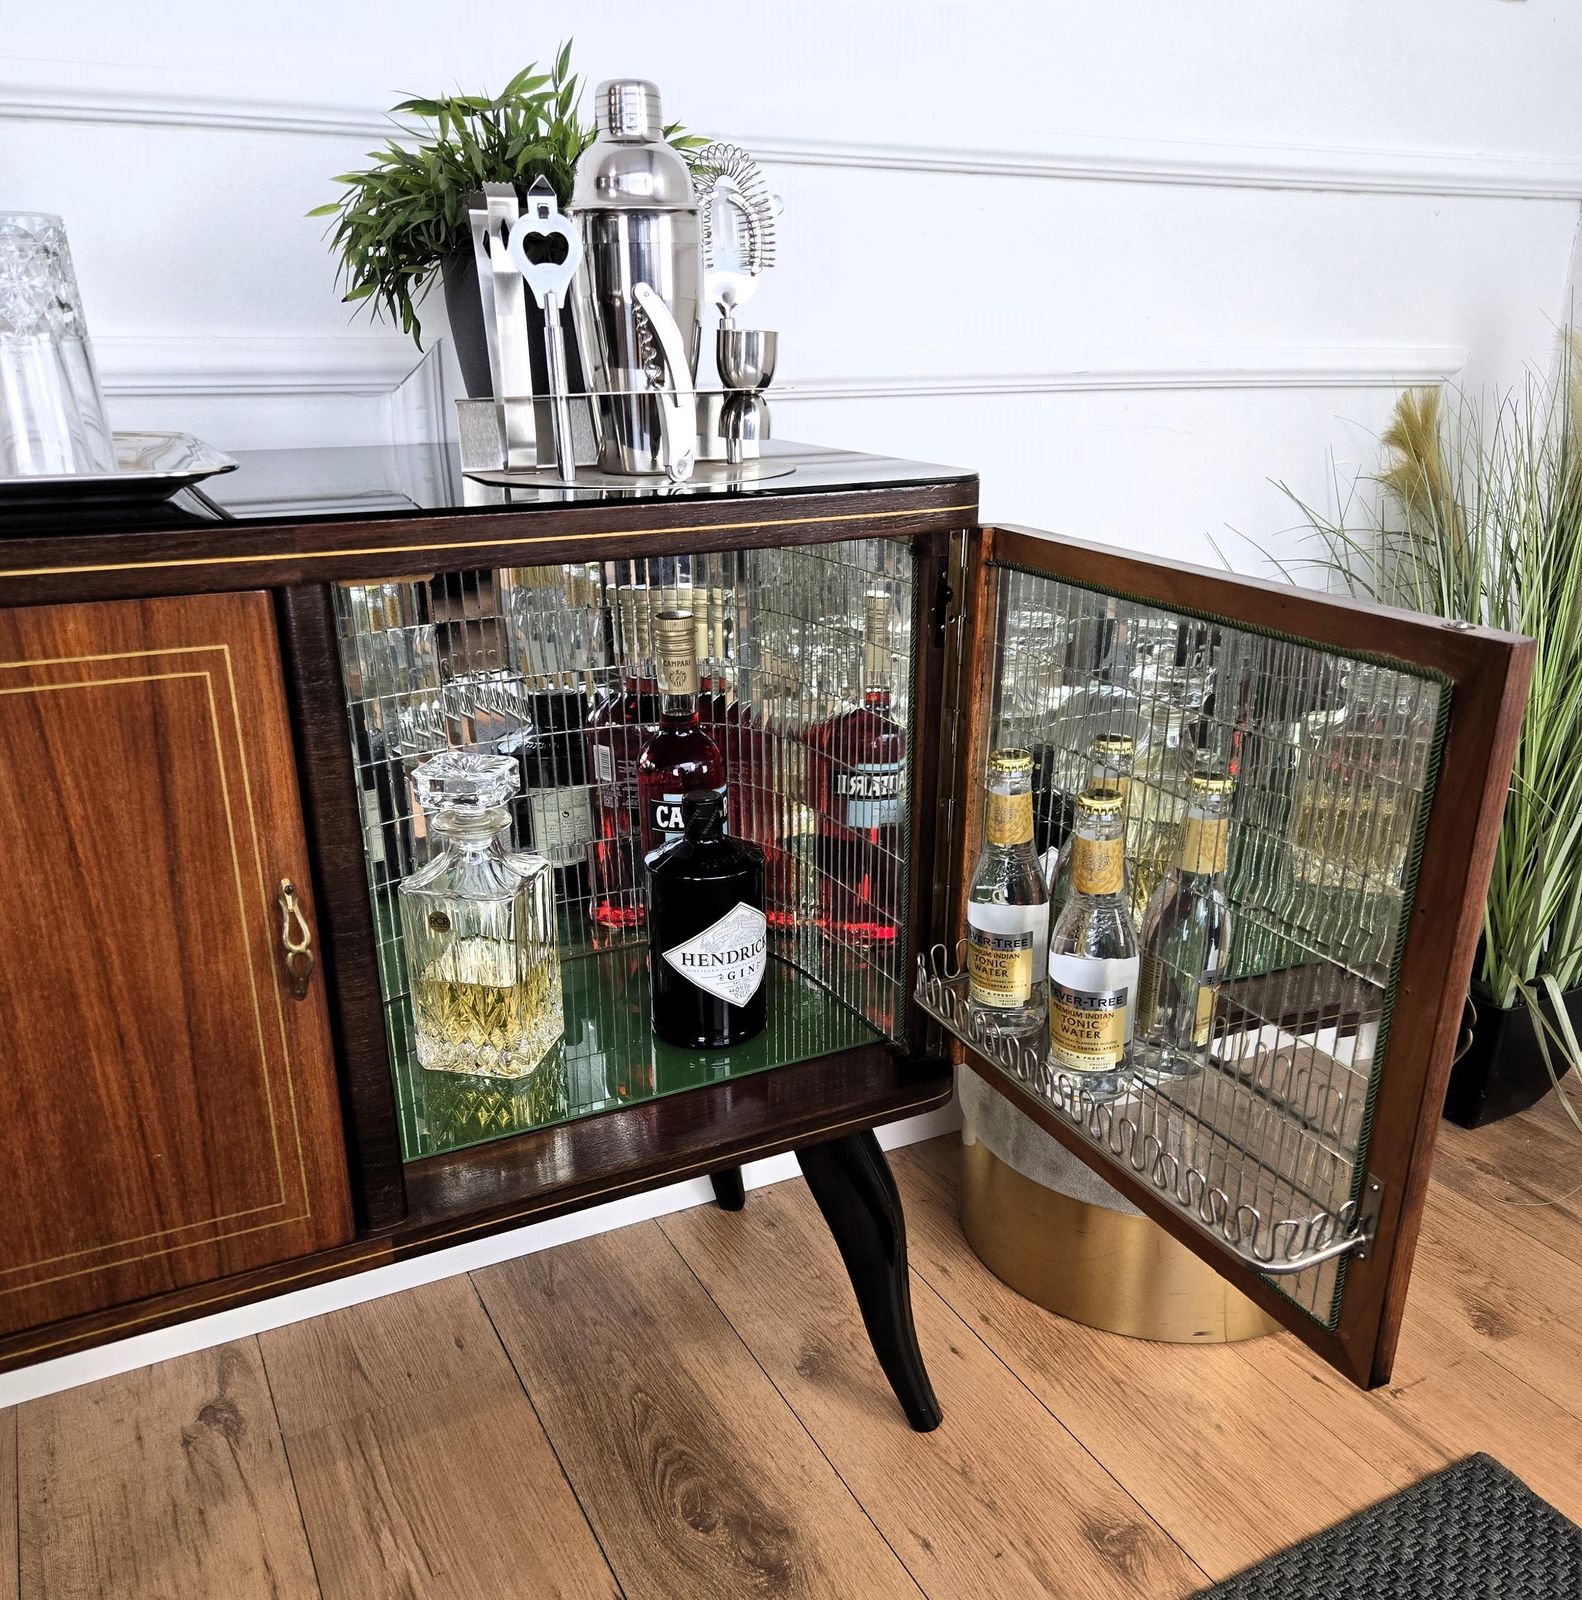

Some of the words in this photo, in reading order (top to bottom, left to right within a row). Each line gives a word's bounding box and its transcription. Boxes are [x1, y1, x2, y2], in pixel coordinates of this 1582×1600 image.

[663, 660, 691, 668] CAMPARI
[430, 917, 450, 927] RCR
[975, 953, 1007, 969] TONIC
[994, 952, 1020, 960] INDIAN
[727, 963, 756, 981] GIN
[975, 964, 1009, 978] WATER
[1053, 1001, 1083, 1019] PREMIUM
[1085, 1012, 1115, 1020] INDIAN
[1061, 1014, 1100, 1030] TONIC
[1061, 1023, 1101, 1039] WATER
